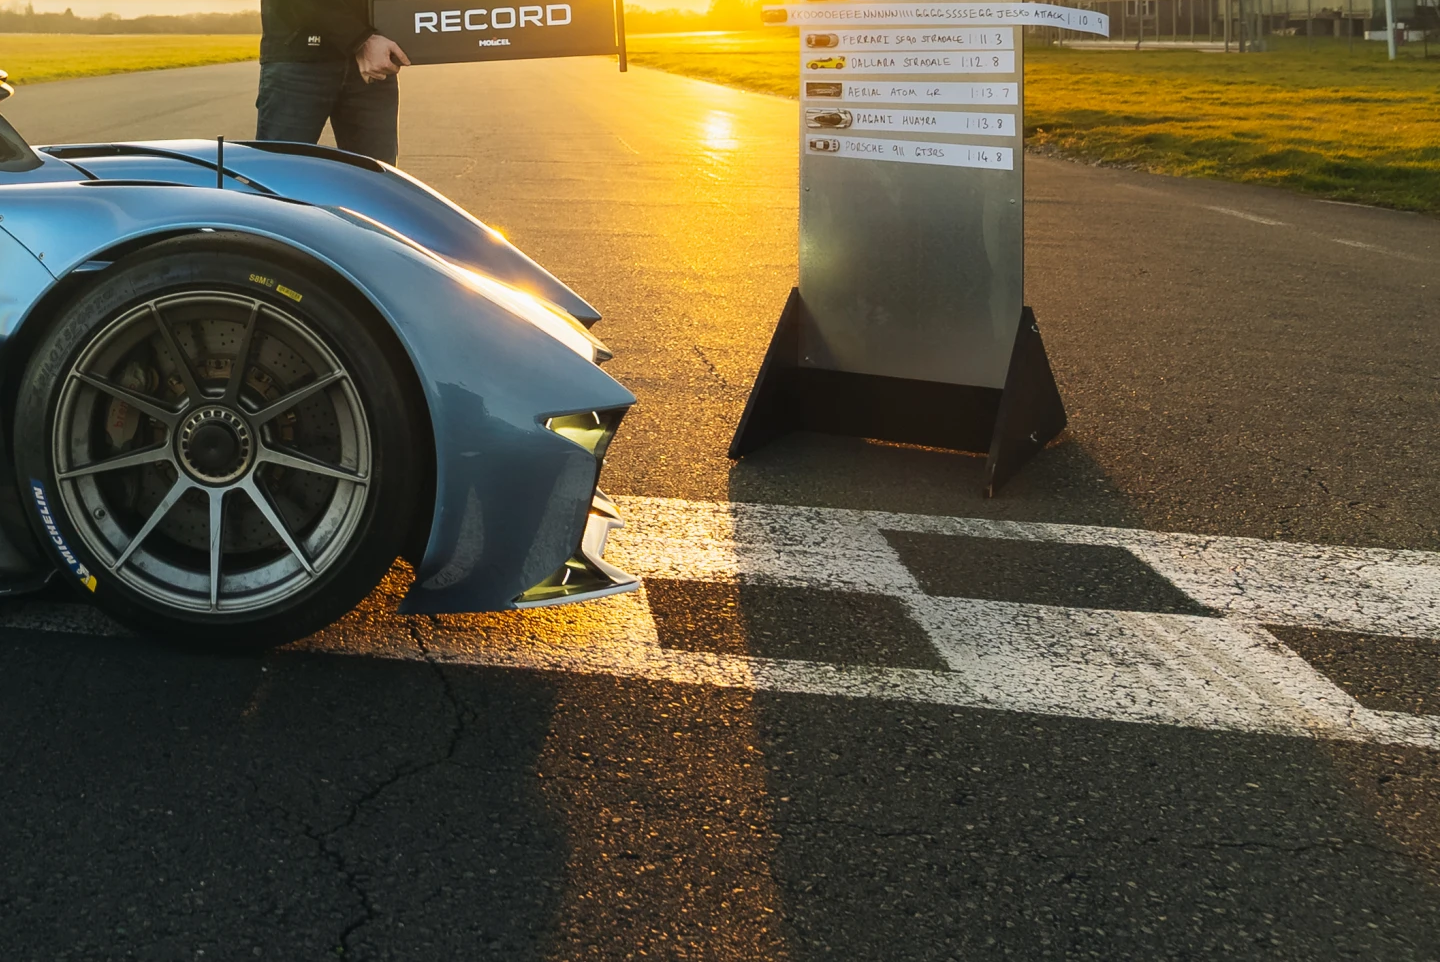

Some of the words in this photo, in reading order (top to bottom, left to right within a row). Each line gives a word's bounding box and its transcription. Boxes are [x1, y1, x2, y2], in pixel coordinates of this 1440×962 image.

[414, 4, 572, 34] RECORD
[996, 8, 1030, 18] JESKO
[1034, 10, 1065, 22] ATTACK
[843, 34, 889, 44] FERRARI
[896, 35, 916, 44] SF90
[921, 34, 964, 44] STRADALE
[852, 58, 895, 68] DALLARA
[903, 57, 951, 68] STRADALE
[848, 86, 882, 96] AERIAL
[890, 88, 918, 96] ATOM
[856, 113, 894, 124] PAGANI
[902, 115, 936, 126] HUAYRA
[846, 141, 884, 154] PORSCHE
[892, 144, 904, 156] 911
[33, 486, 77, 564] MICHELIN
